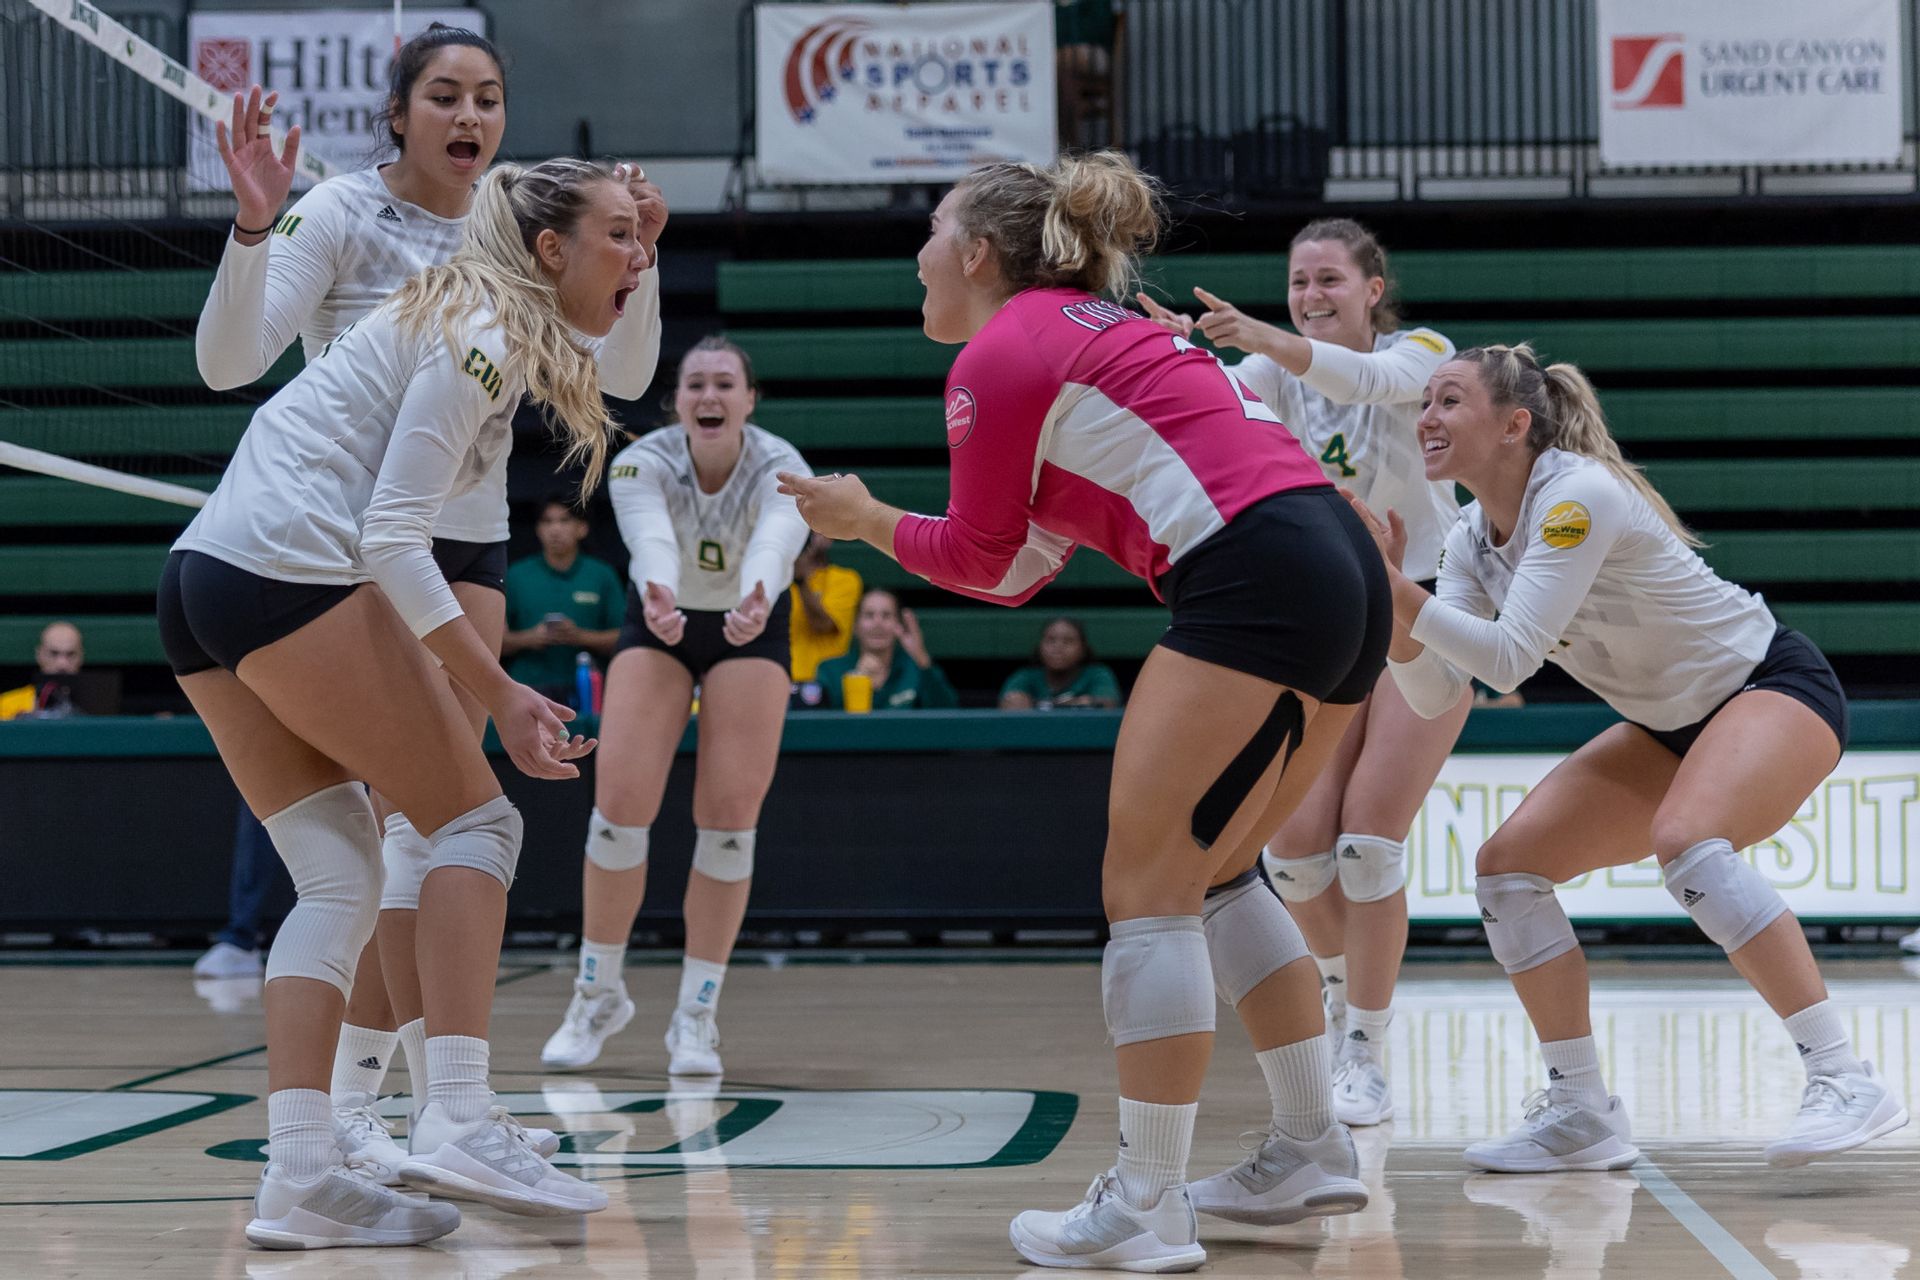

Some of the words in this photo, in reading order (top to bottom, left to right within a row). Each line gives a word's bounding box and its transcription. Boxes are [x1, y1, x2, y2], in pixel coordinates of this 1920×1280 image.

[261, 33, 397, 90] Hilt
[1702, 39, 1771, 67] SAND
[1777, 38, 1886, 67] CANYON
[866, 54, 1031, 95] SPORTS
[1702, 67, 1808, 97] URGENT
[1817, 66, 1886, 95] CARE
[1320, 432, 1357, 478] 4
[698, 540, 726, 572] 9
